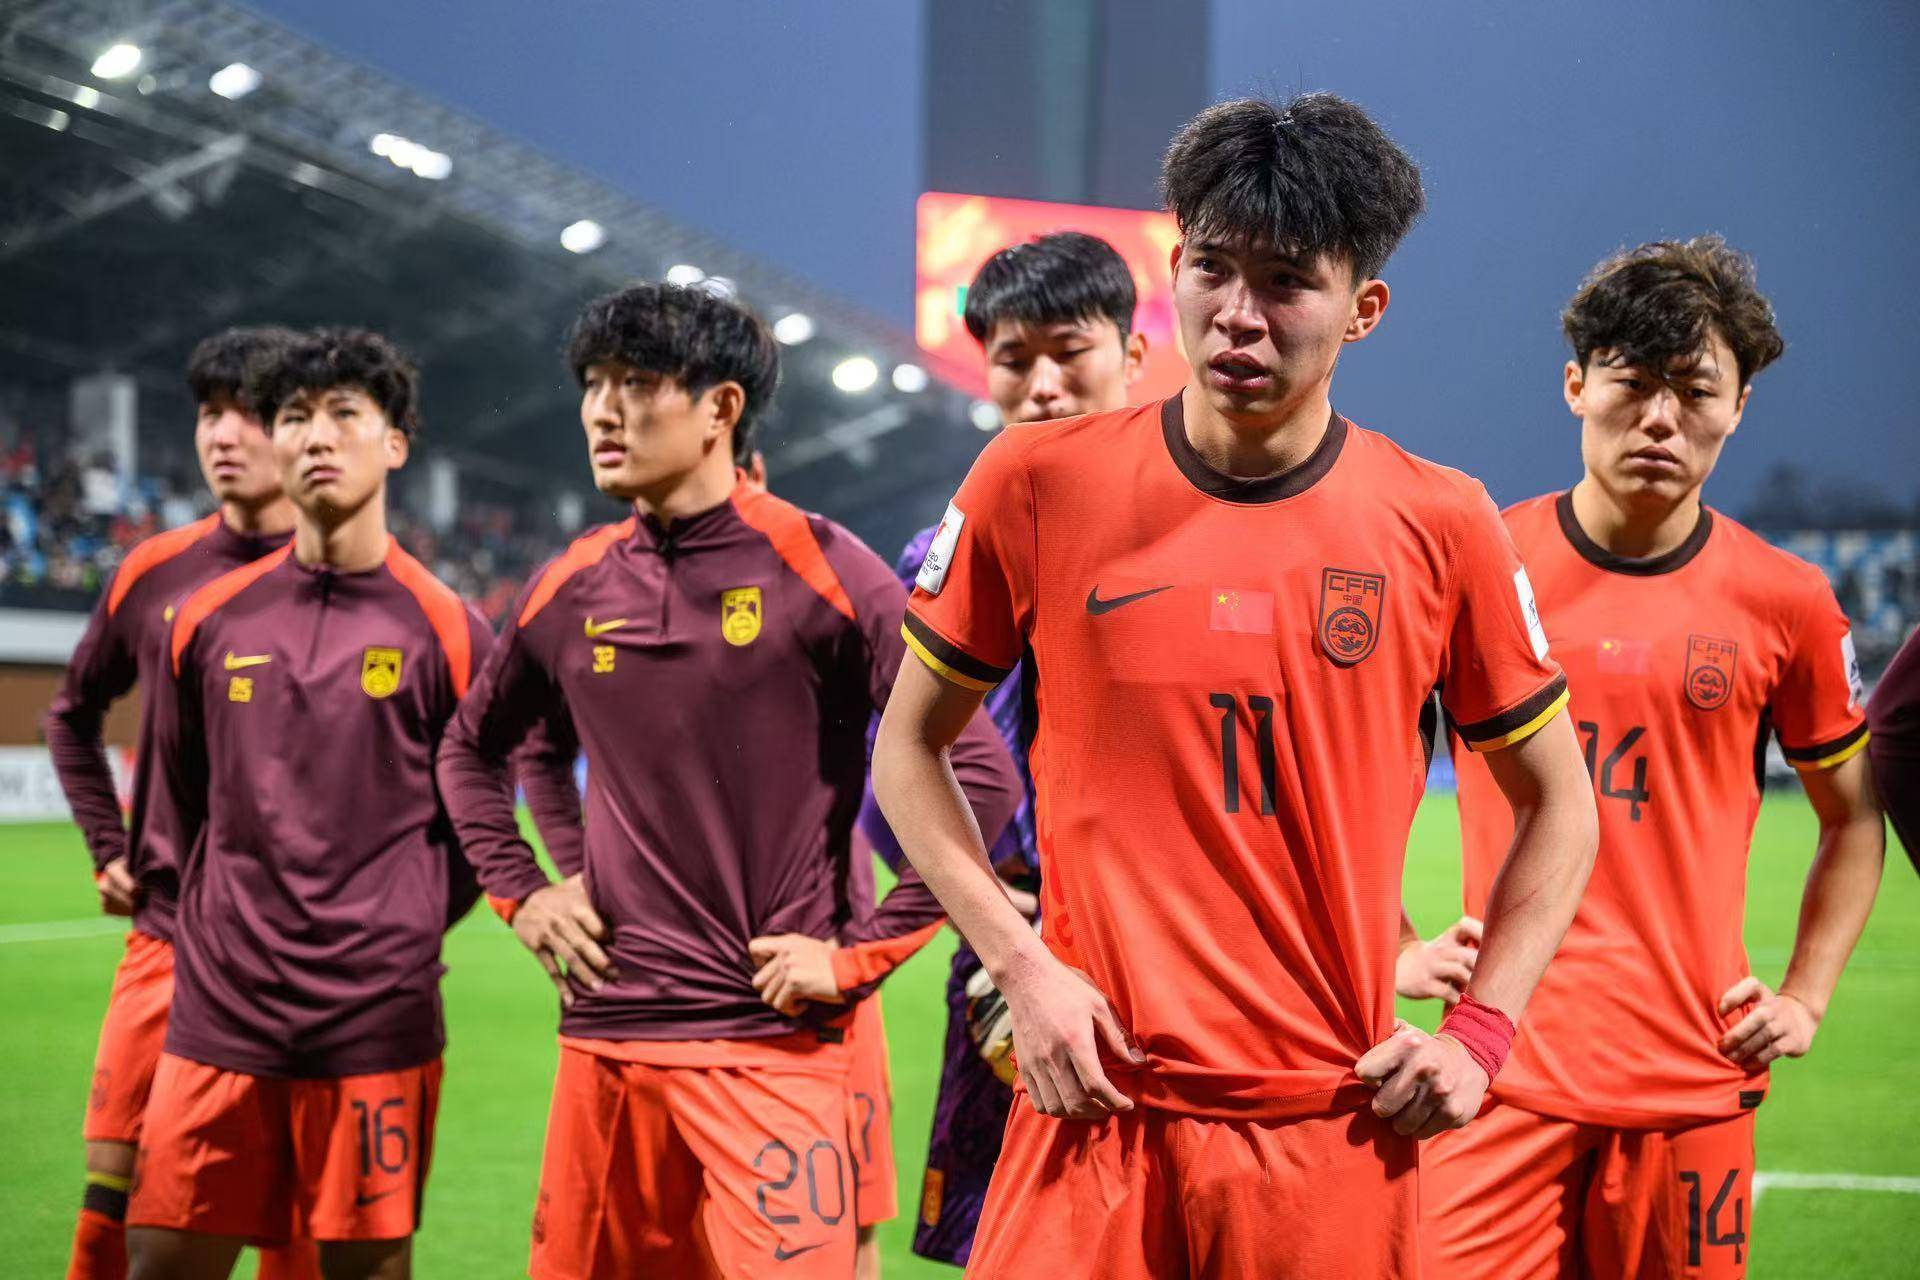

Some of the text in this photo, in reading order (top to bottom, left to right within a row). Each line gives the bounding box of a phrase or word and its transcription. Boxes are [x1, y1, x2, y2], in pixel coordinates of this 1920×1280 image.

[1328, 574, 1379, 597] CFA
[1342, 594, 1363, 606] 中国
[1209, 692, 1276, 816] 11
[1578, 720, 1650, 822] 14
[351, 1096, 410, 1179] 16
[753, 1138, 846, 1226] 20
[1679, 1168, 1745, 1267] 14
